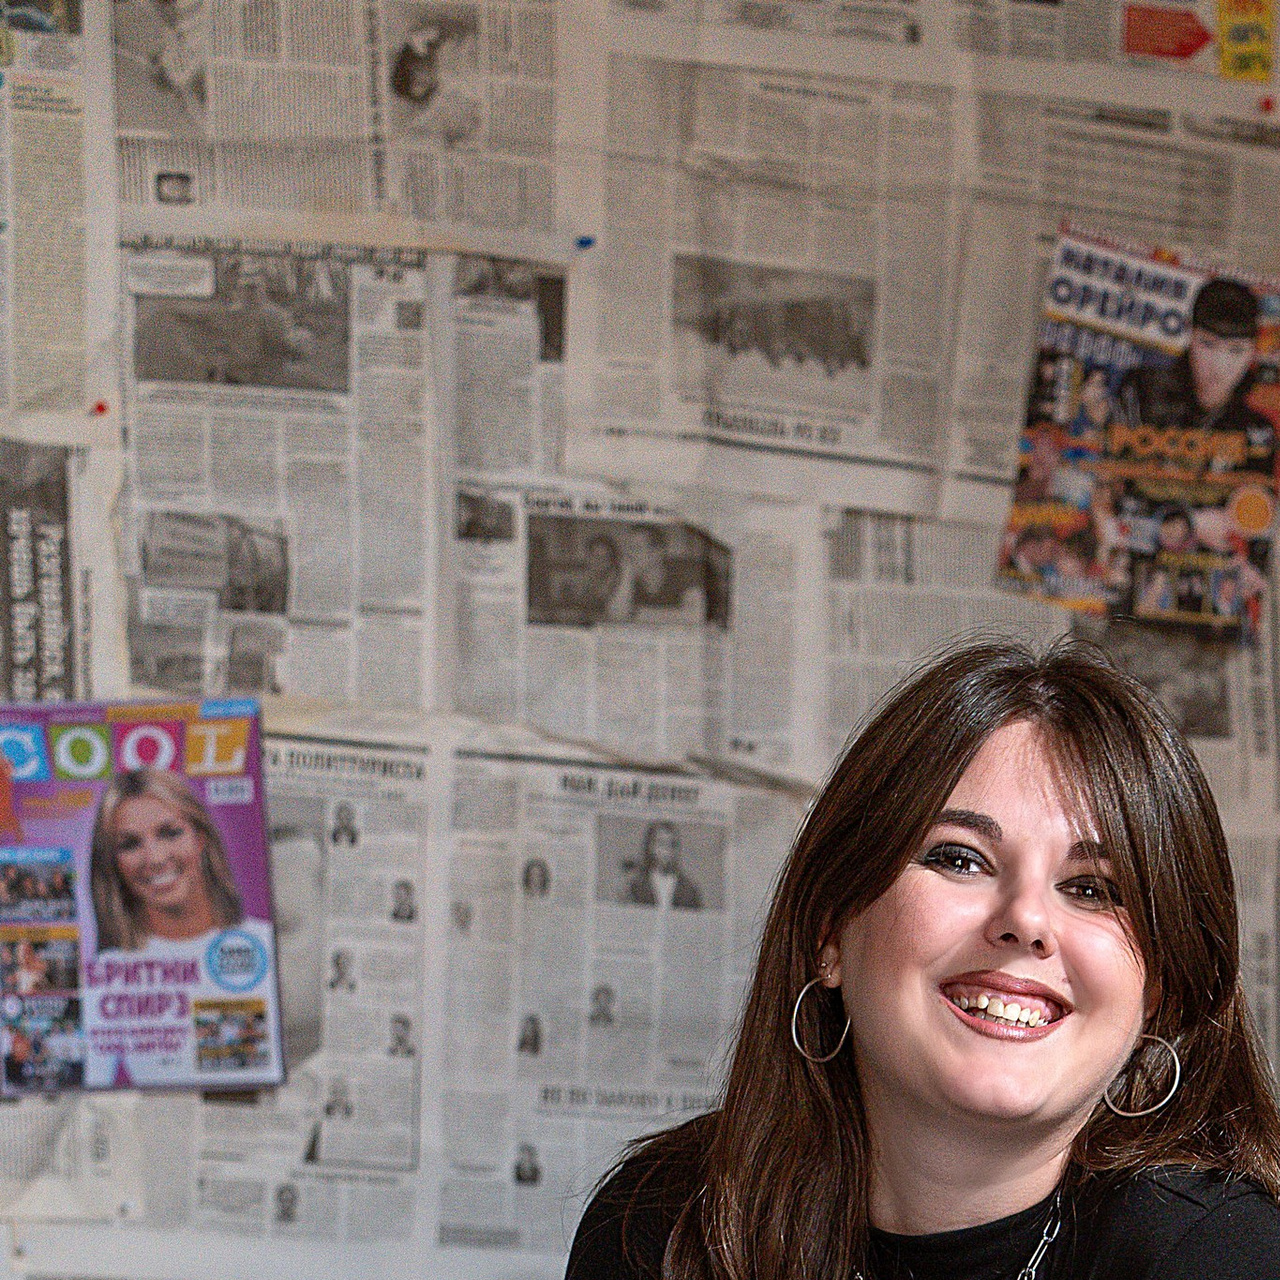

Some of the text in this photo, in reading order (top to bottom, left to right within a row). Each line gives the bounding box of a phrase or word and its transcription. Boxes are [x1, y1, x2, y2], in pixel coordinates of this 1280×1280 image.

[1051, 276, 1185, 336] ОРЕЙРО
[0, 725, 247, 779] COOL
[85, 958, 200, 986] БРИТНИ
